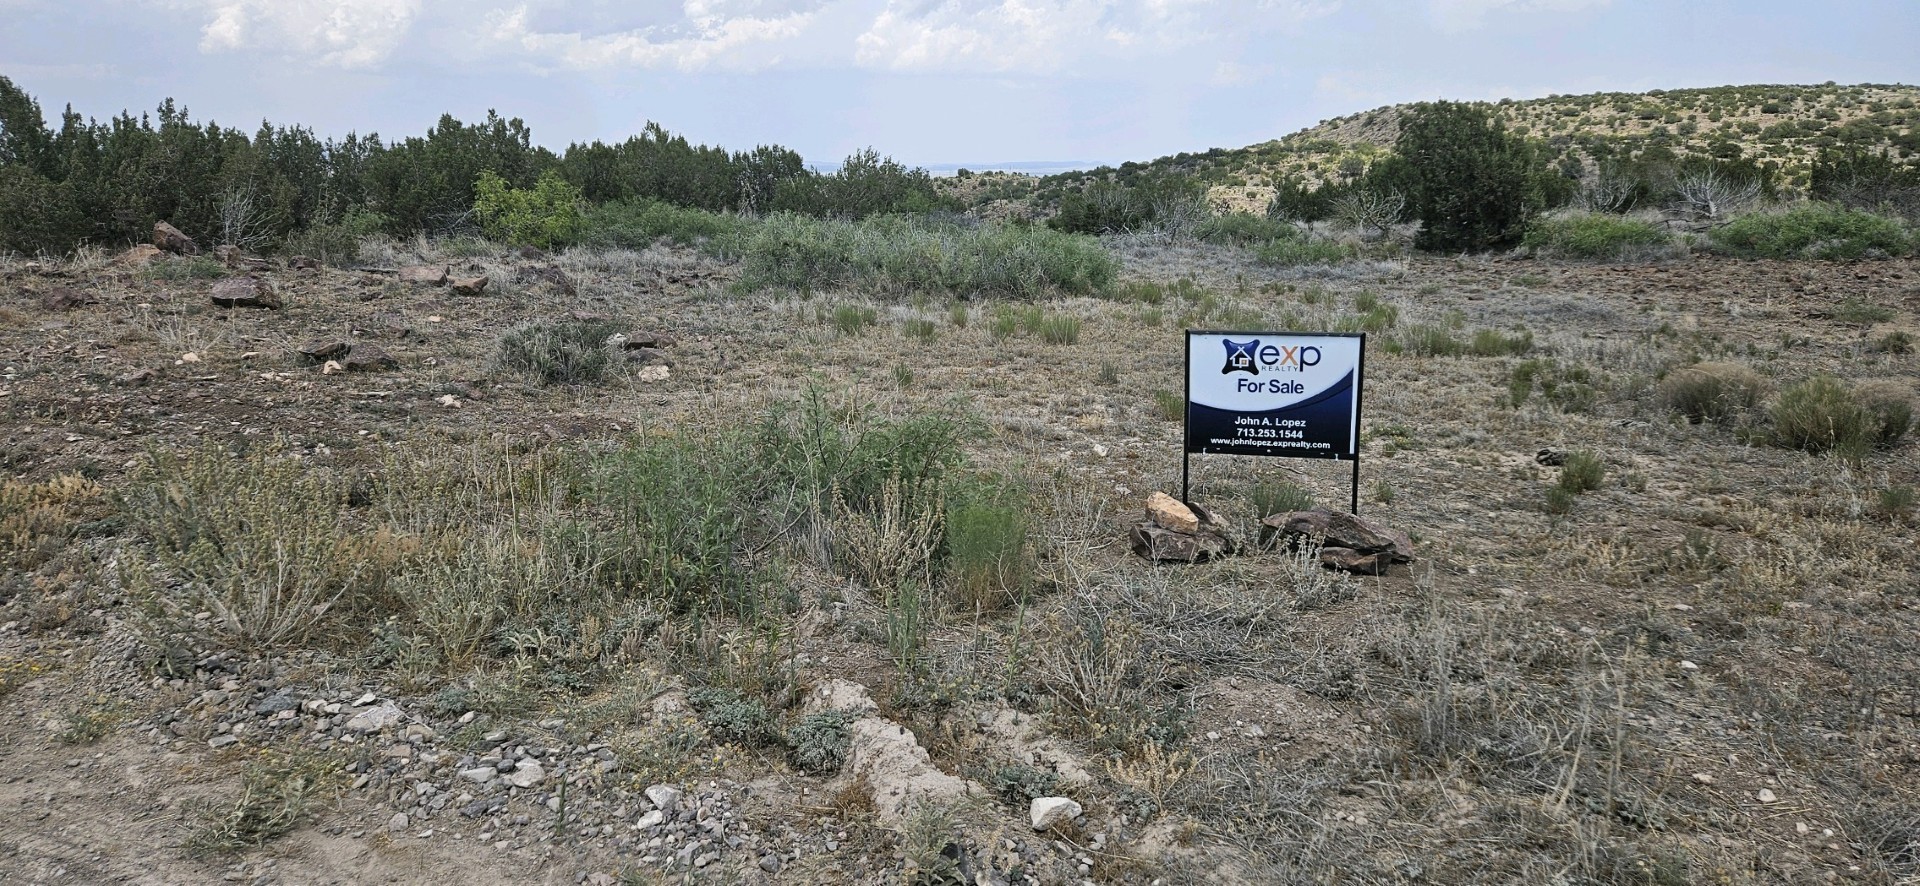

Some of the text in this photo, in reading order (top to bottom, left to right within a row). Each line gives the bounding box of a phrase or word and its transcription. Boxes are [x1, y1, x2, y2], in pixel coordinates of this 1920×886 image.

[1259, 345, 1321, 372] exp
[1237, 378, 1304, 394] For Sale
[1234, 416, 1306, 428] John A. Lopez
[1236, 428, 1303, 439] 713.253.1544
[1210, 437, 1331, 449] www.johnlopez.exprealty.com
